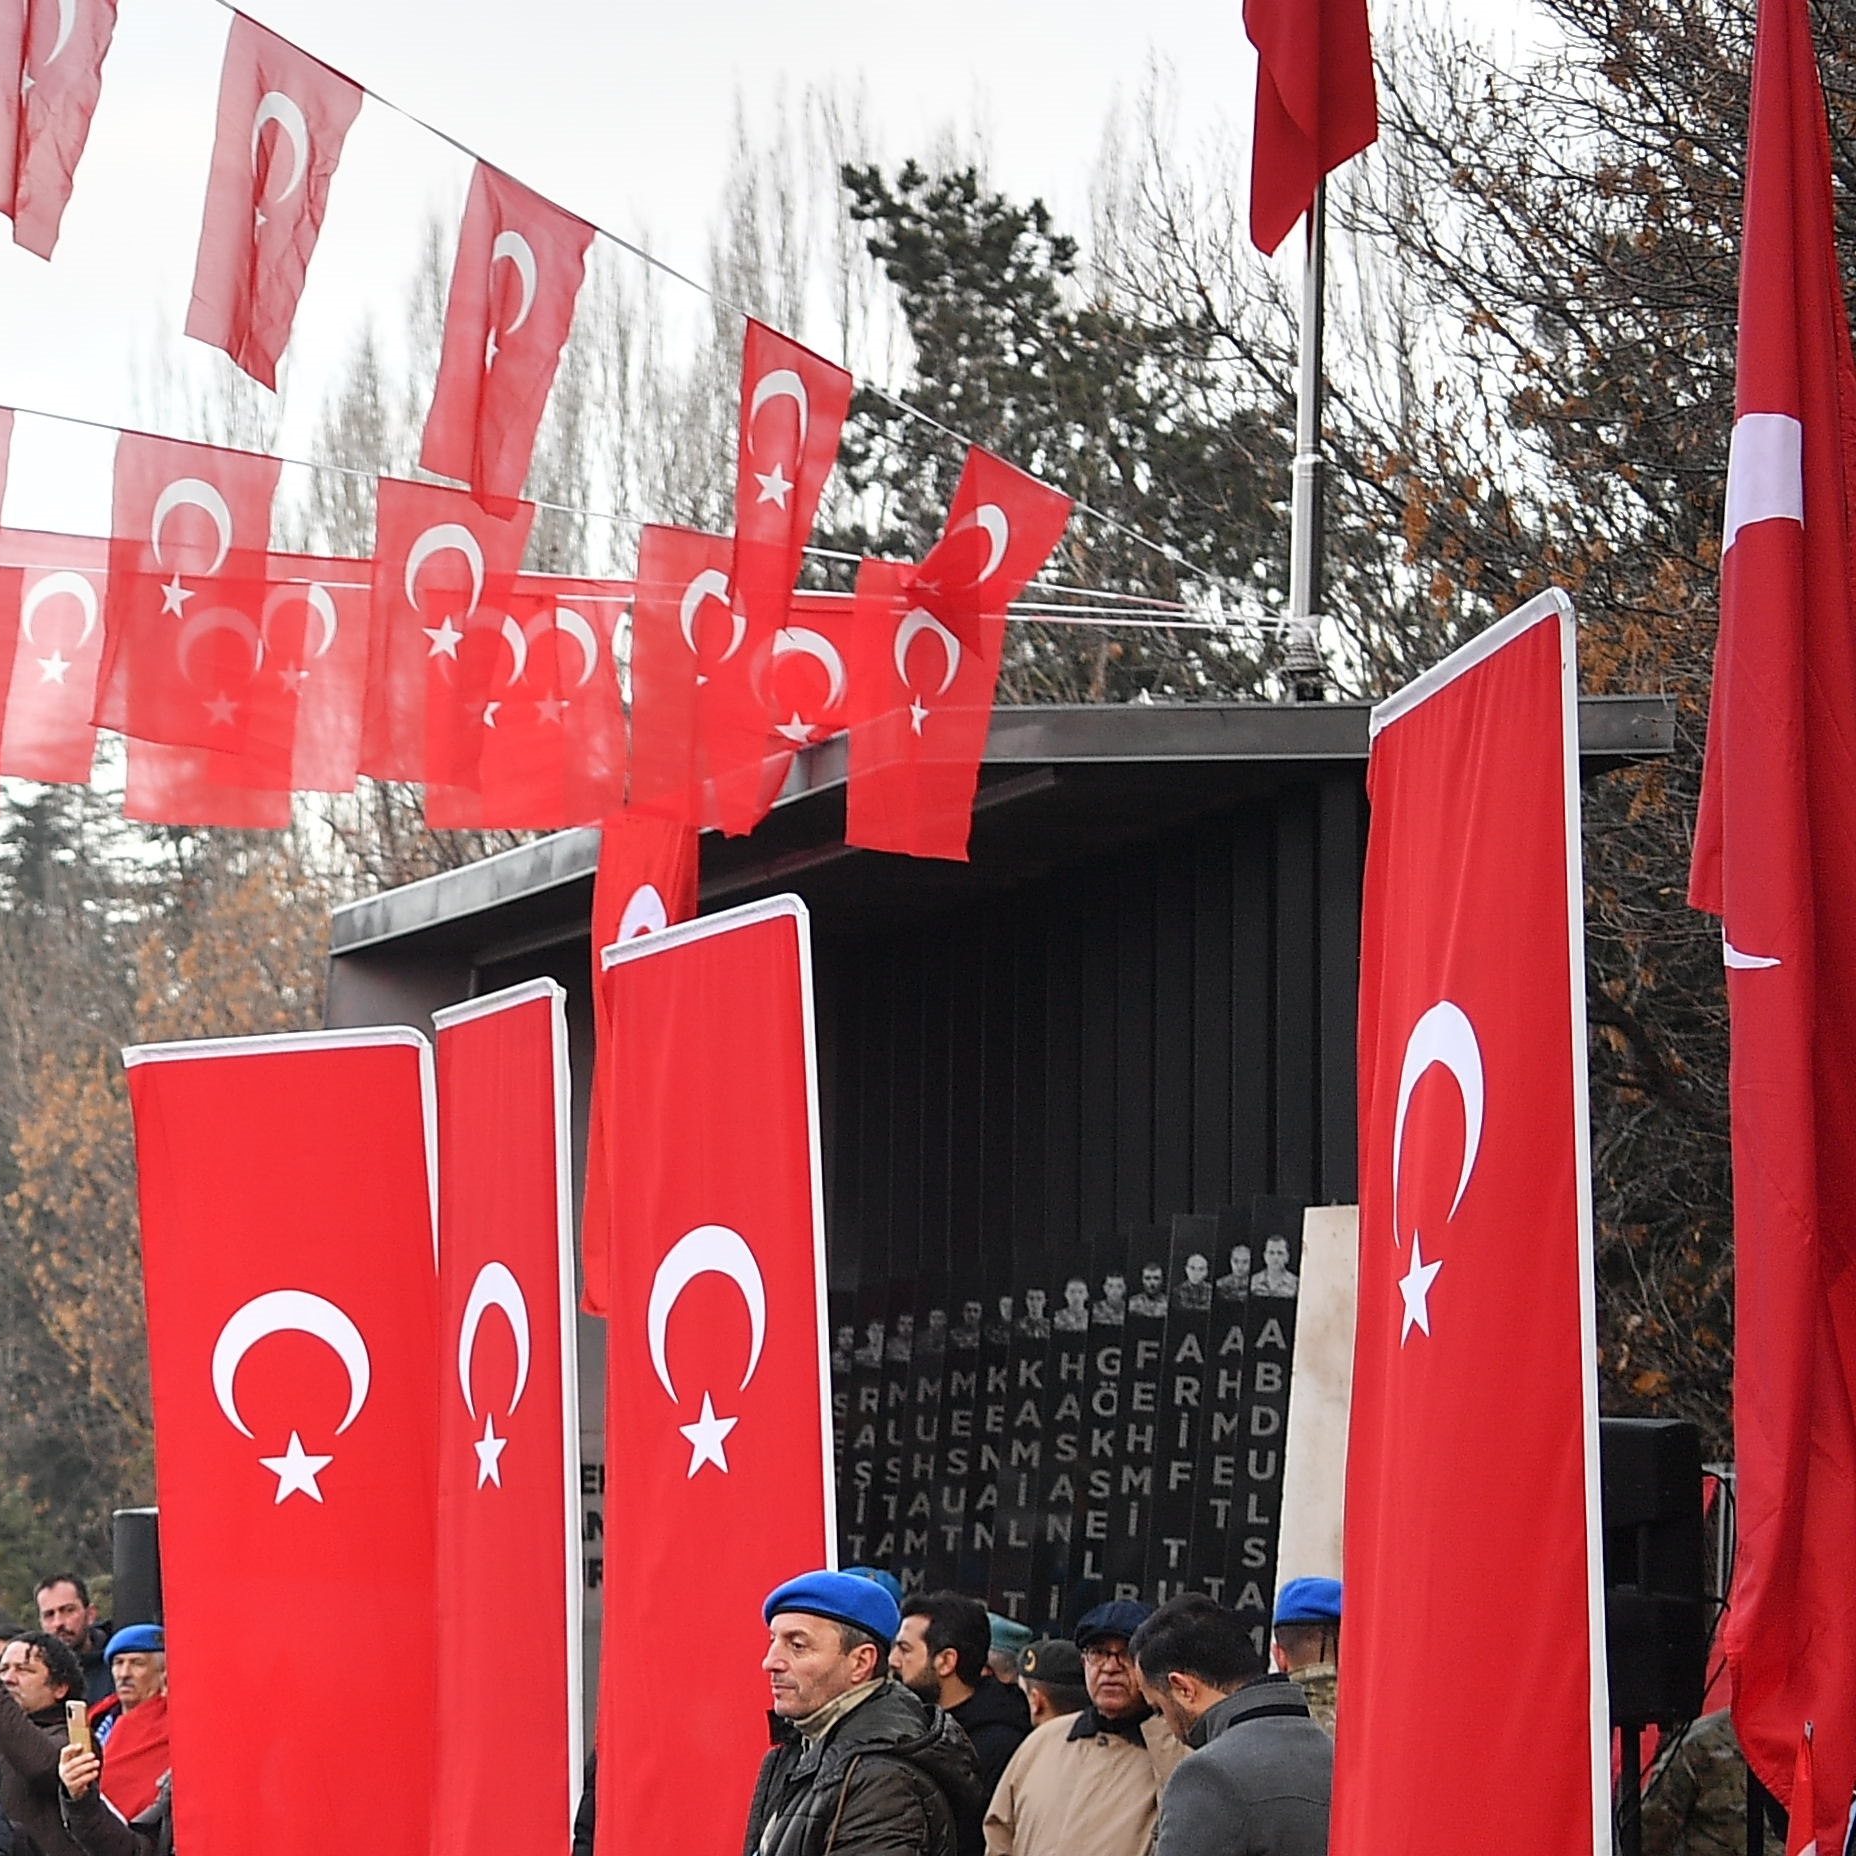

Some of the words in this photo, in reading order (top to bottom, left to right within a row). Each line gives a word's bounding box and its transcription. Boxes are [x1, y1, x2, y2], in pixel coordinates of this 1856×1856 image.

[847, 1386, 880, 1561] RAŞİT
[940, 1370, 977, 1552] MESUT
[973, 1365, 1008, 1551] KENAN
[1008, 1358, 1043, 1547] KAMİL
[1046, 1351, 1086, 1544] HASAN
[1083, 1347, 1123, 1581] GÖKSEL
[1120, 1339, 1160, 1537] FEHMİ
[1167, 1332, 1204, 1492] ARİF
[1208, 1324, 1244, 1529] AHMET
